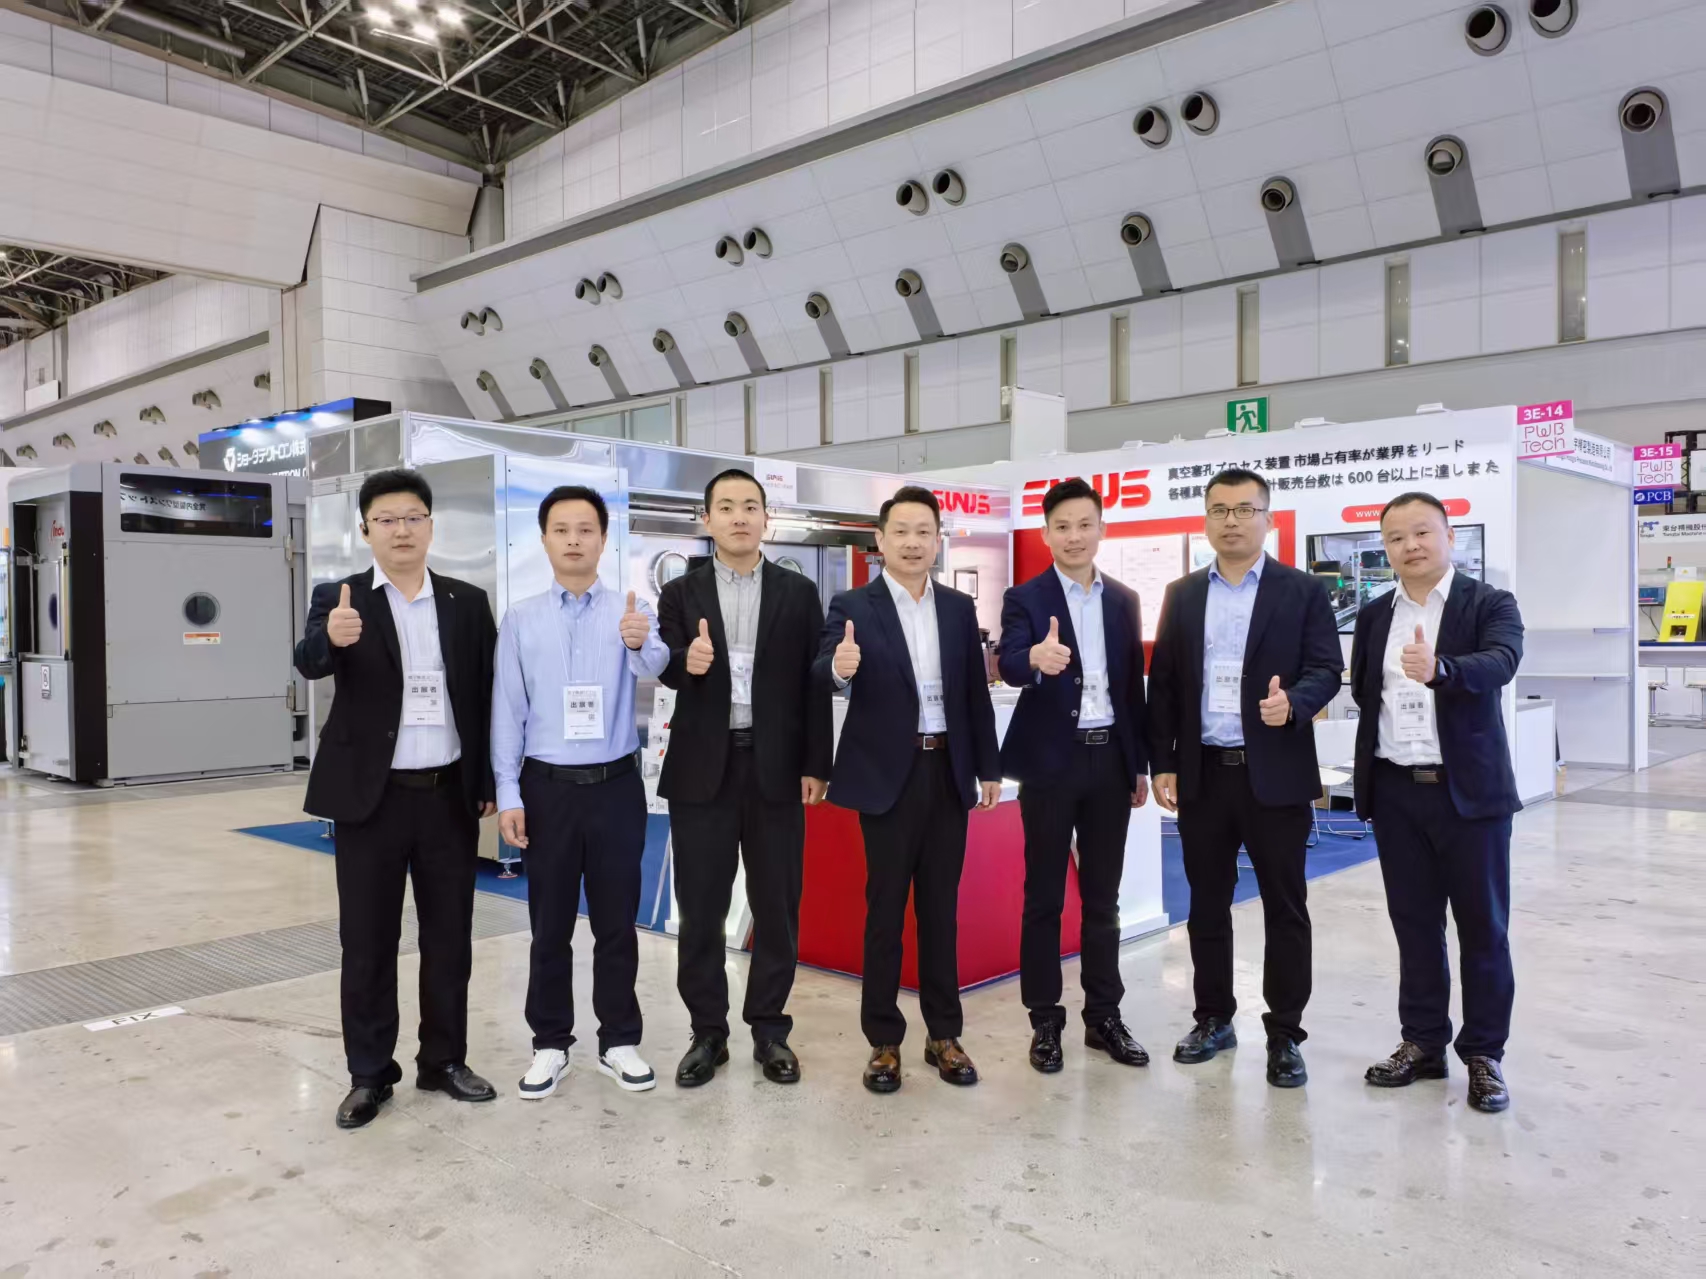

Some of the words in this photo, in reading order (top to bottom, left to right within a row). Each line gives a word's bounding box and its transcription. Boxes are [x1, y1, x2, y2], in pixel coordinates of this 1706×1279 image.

[1523, 404, 1564, 421] 3E-14
[1524, 422, 1565, 440] PWB
[1521, 436, 1566, 454] Tech
[1640, 446, 1674, 458] 3E-15
[1640, 460, 1674, 473] PWB
[1347, 470, 1374, 485] 600
[1637, 472, 1674, 485] Tech
[1647, 491, 1672, 503] PCB
